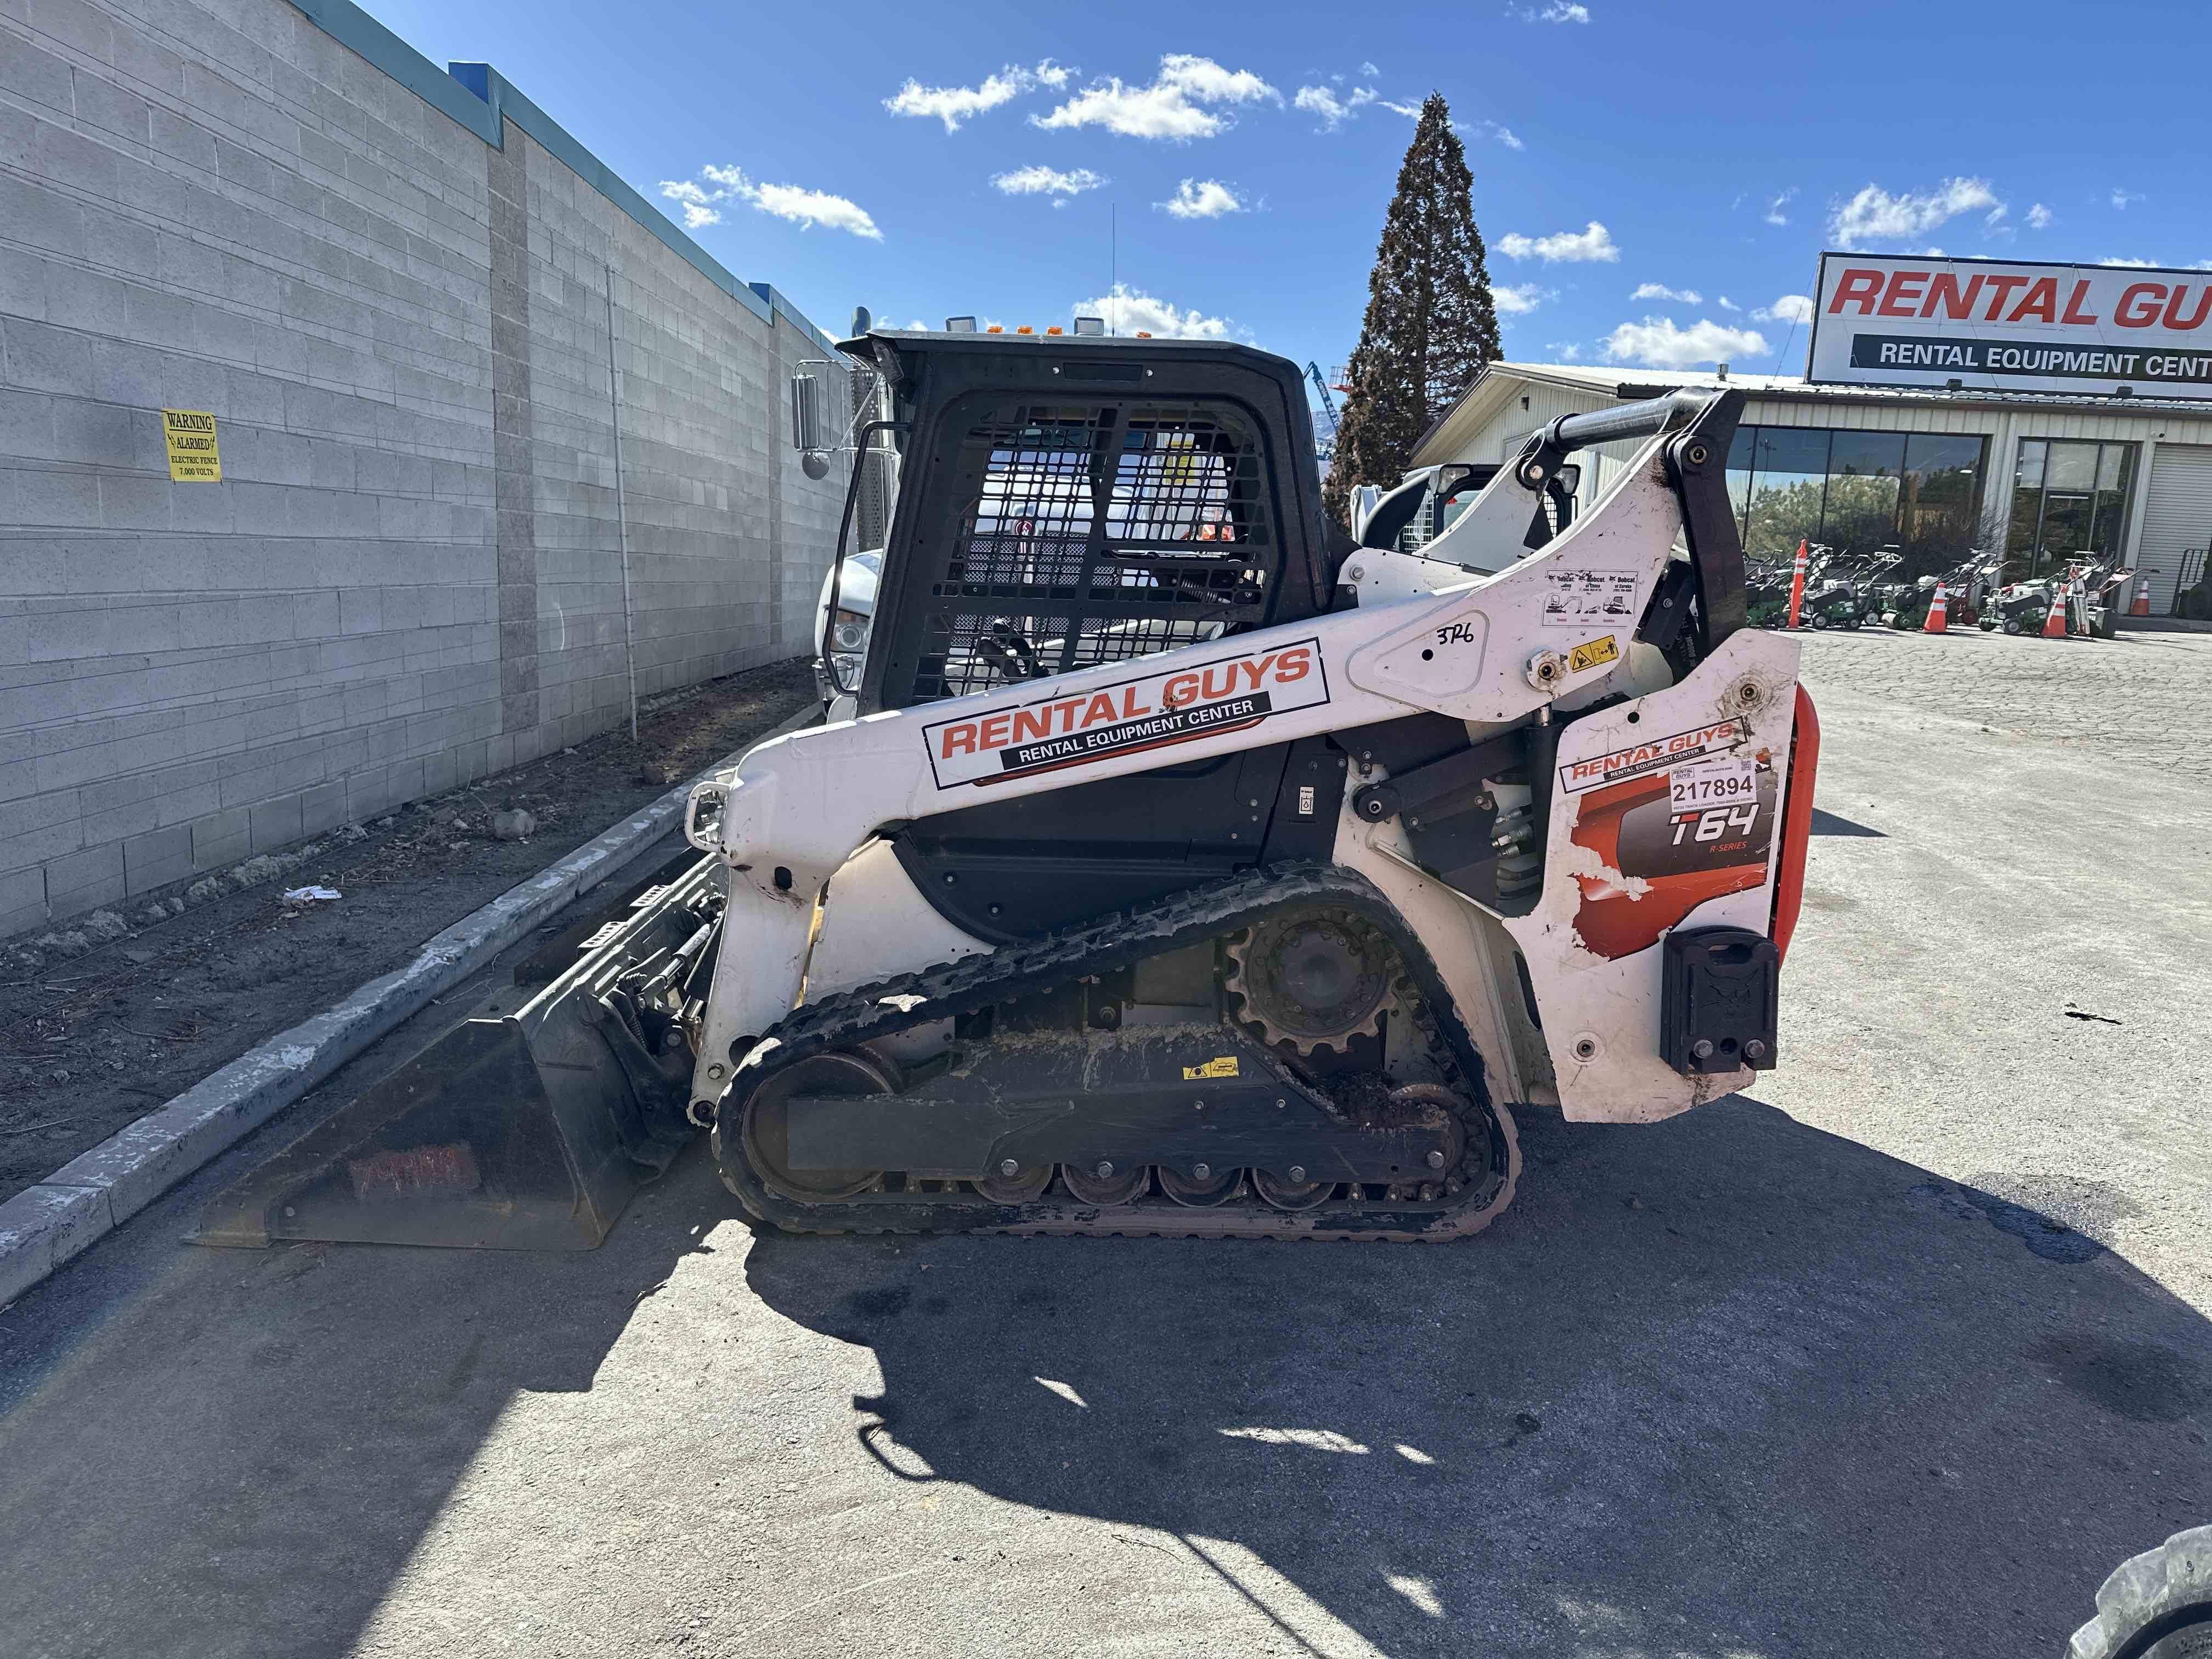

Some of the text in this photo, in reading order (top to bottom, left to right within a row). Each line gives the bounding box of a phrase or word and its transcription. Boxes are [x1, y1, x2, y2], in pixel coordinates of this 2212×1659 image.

[1827, 268, 2098, 325] RENTAL
[1880, 343, 1978, 367] RENTAL
[1987, 347, 2140, 374] EQUIPMENT
[167, 413, 212, 430] WARNING
[177, 437, 210, 450] ALARMED
[171, 455, 218, 465] ELECTRIC FENCE
[179, 467, 195, 476] 7,000
[942, 648, 1311, 759] RENTAL GUYS
[1019, 699, 1254, 763] RENTAL EQUIPMENT CENTER
[1572, 724, 1734, 780] RENTAL GUYS
[1610, 748, 1700, 777] RENTAL EQUIPMENT CENTER
[1673, 775, 1753, 802] 217894
[1671, 804, 1759, 845] T64
[1709, 841, 1747, 852] R-SERIES
